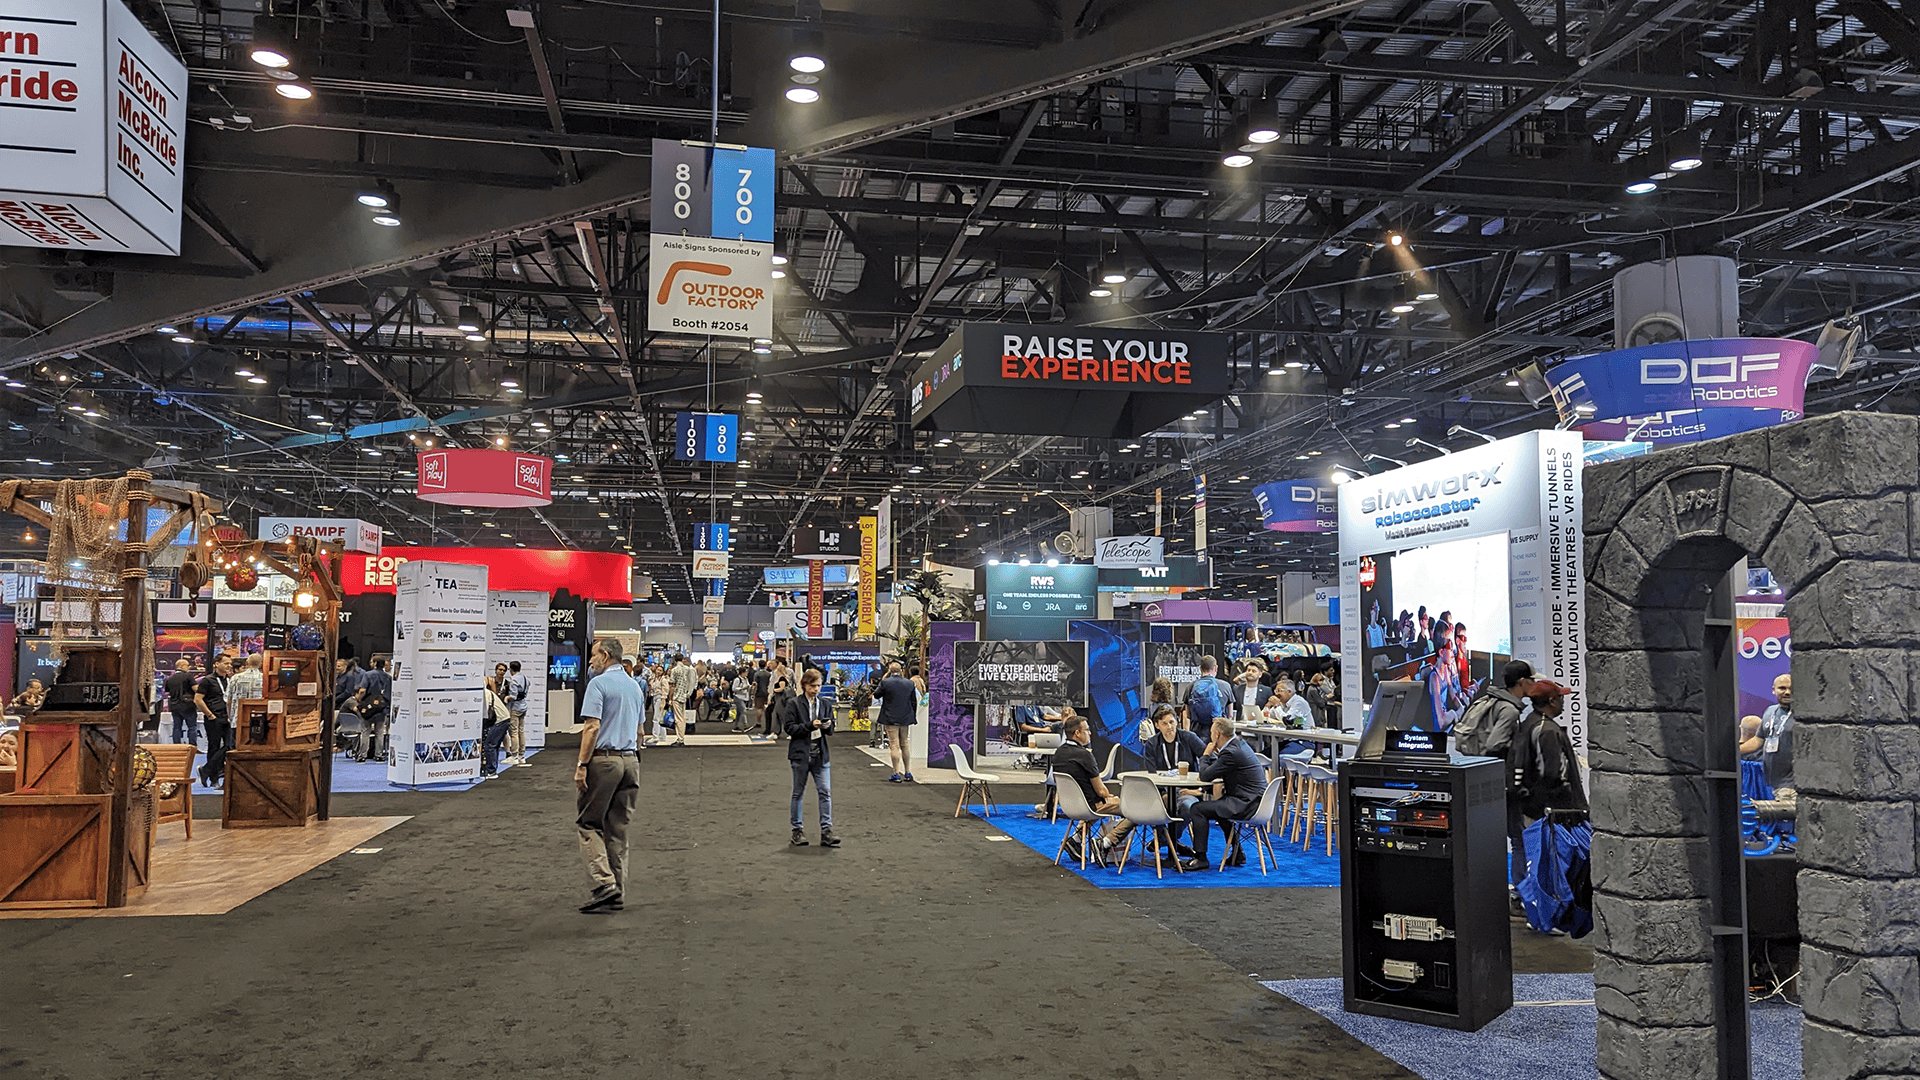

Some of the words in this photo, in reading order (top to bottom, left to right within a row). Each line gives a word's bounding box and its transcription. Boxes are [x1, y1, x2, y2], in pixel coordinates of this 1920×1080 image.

[118, 50, 167, 118] Alcorn
[118, 89, 177, 167] McBride
[118, 132, 145, 180] Inc.
[673, 163, 691, 219] 800
[735, 169, 753, 224] 700
[663, 242, 684, 250] Aisle
[685, 244, 706, 253] Signs
[708, 246, 749, 256] Sponsored
[751, 249, 761, 257] by
[682, 283, 764, 300] OUTDOOR
[688, 296, 758, 310] FACTORY
[673, 318, 709, 331] Booth
[711, 321, 750, 336] #2054
[1003, 335, 1094, 360] RAISE
[1102, 339, 1188, 363] YOUR
[1001, 355, 1191, 384] EXPERIENCE
[1641, 353, 1780, 384] DOF
[1691, 386, 1778, 401] Robotics
[686, 419, 696, 458] 1000
[717, 425, 727, 454] 900
[425, 459, 439, 473] Soft
[427, 468, 443, 482] Play
[520, 464, 537, 476] Soft
[1563, 452, 1574, 492] RIDES
[523, 472, 540, 487] Play
[1361, 466, 1502, 514] simworx
[1547, 448, 1559, 512] TUNNELS
[1565, 494, 1575, 515] VR
[293, 526, 346, 537] RAMPF
[1510, 536, 1519, 545] WE
[1519, 532, 1539, 543] SUPPLY
[862, 536, 873, 567] QUICK
[1101, 539, 1152, 564] Telescope
[1550, 515, 1562, 592] IMMERSIVE
[1138, 566, 1169, 578] TAIT
[1566, 530, 1578, 598] THEATRES
[435, 578, 458, 589] TEA
[1031, 576, 1055, 586] RWS
[498, 600, 517, 608] TEA
[862, 569, 872, 625] ASSEMBLY
[1045, 602, 1061, 611] JRA
[549, 609, 575, 622] GPX
[810, 592, 822, 628] DESIGN
[1552, 603, 1563, 636] RIDE
[1567, 601, 1581, 687] SIMULATION
[979, 663, 1003, 674] EVERY
[1004, 664, 1023, 674] STEP
[1024, 664, 1035, 674] OF
[1037, 664, 1060, 675] YOUR
[1553, 640, 1564, 678] DARK
[979, 673, 998, 682] LIVE
[1000, 673, 1059, 682] EXPERIENCE
[1571, 691, 1582, 748] MOTION
[1398, 741, 1433, 750] Integration
[1404, 734, 1429, 743] System
[428, 768, 474, 778] teaconnect.org
